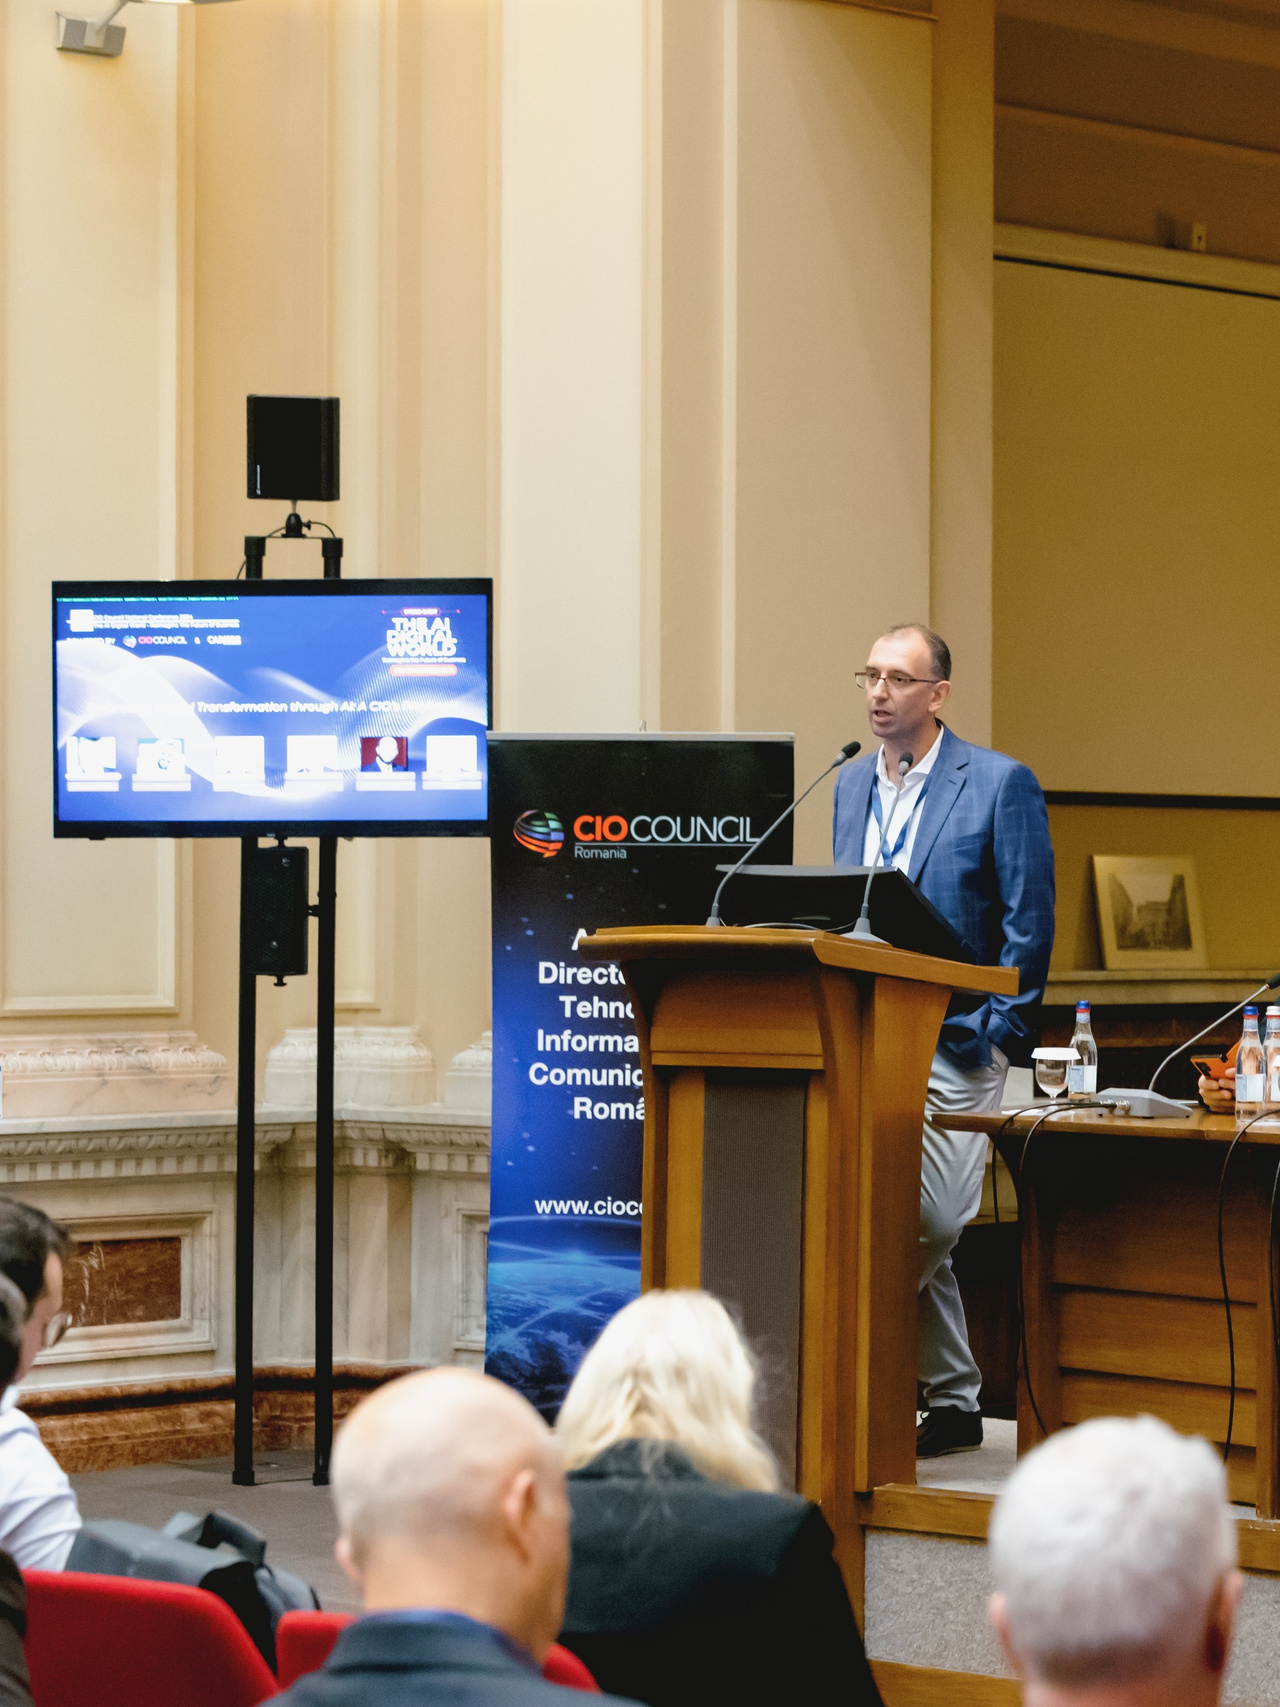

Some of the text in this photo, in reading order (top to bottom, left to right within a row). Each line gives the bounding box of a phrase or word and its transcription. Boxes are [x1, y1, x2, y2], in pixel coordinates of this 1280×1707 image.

[391, 617, 451, 632] THE AI
[197, 701, 288, 713] Transformation
[290, 701, 338, 715] through
[575, 846, 627, 860] Romania
[537, 1028, 639, 1053] Informa
[535, 1196, 643, 1216] www.cioc
